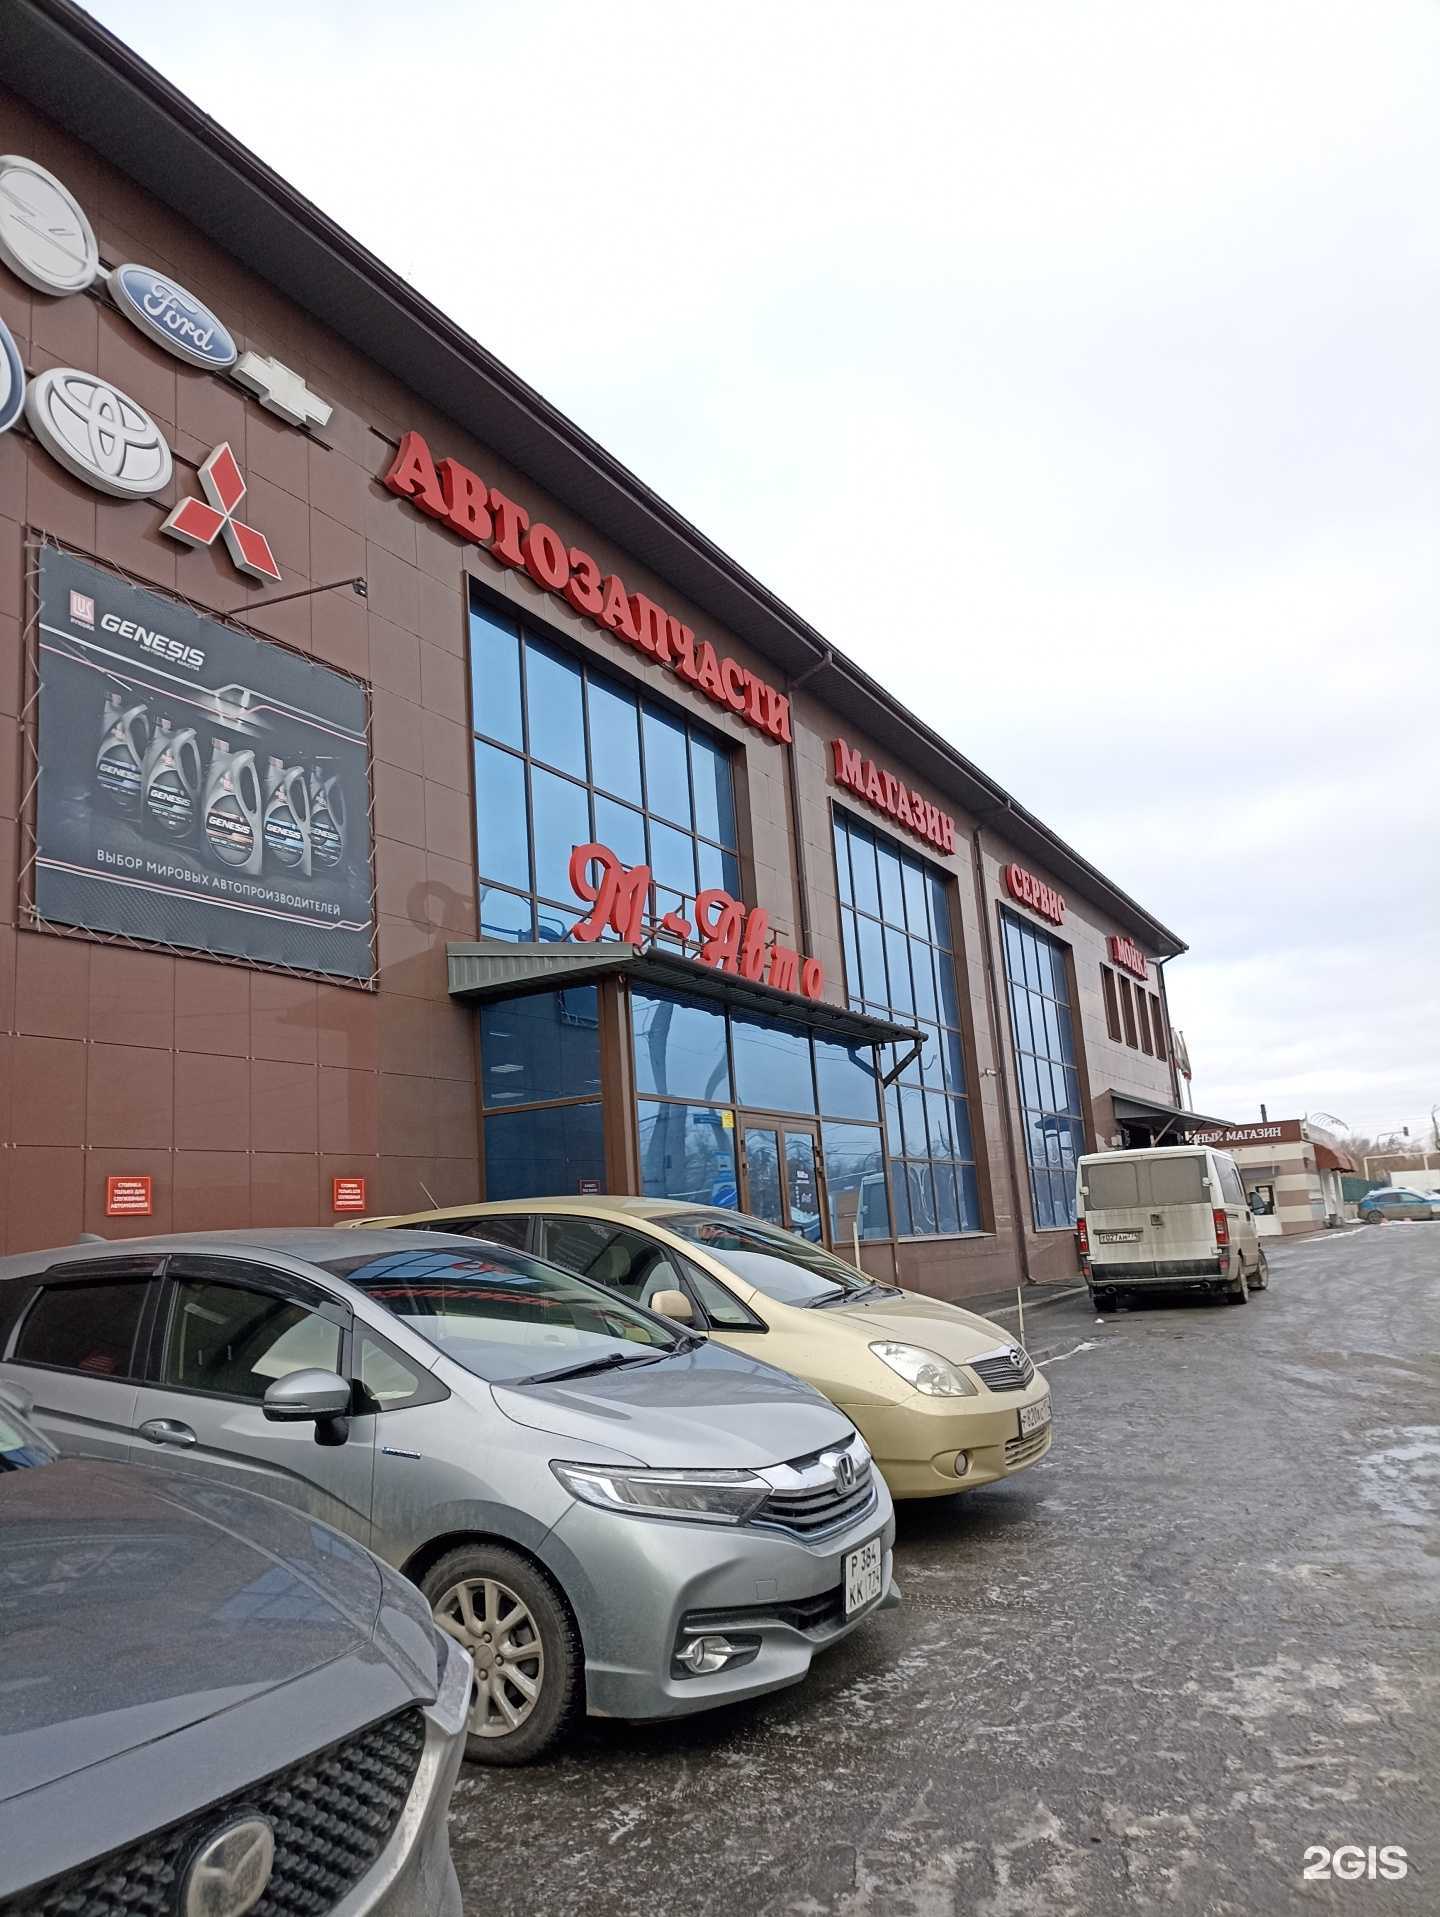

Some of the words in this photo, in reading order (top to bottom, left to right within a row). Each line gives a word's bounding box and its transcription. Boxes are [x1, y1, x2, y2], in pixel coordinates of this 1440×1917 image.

[143, 284, 215, 351] Ford
[384, 431, 793, 745] АВТОЗАПЧАСТИ
[100, 613, 206, 667] GENESIS
[149, 789, 192, 807] GENESIS
[831, 737, 956, 856] МАГАЗИН
[207, 815, 251, 835] GENESIS
[266, 823, 303, 840] GENESIS
[96, 849, 143, 869] ВЫБОР
[146, 861, 209, 886] МИРОВЫХ
[212, 877, 341, 917] АВТОПРОИЗВОДИТЕЛЕЙ
[1006, 862, 1066, 926] СЕРВИС
[1110, 935, 1149, 981] МОЙКА
[1226, 1126, 1282, 1141] МАГАЗИН
